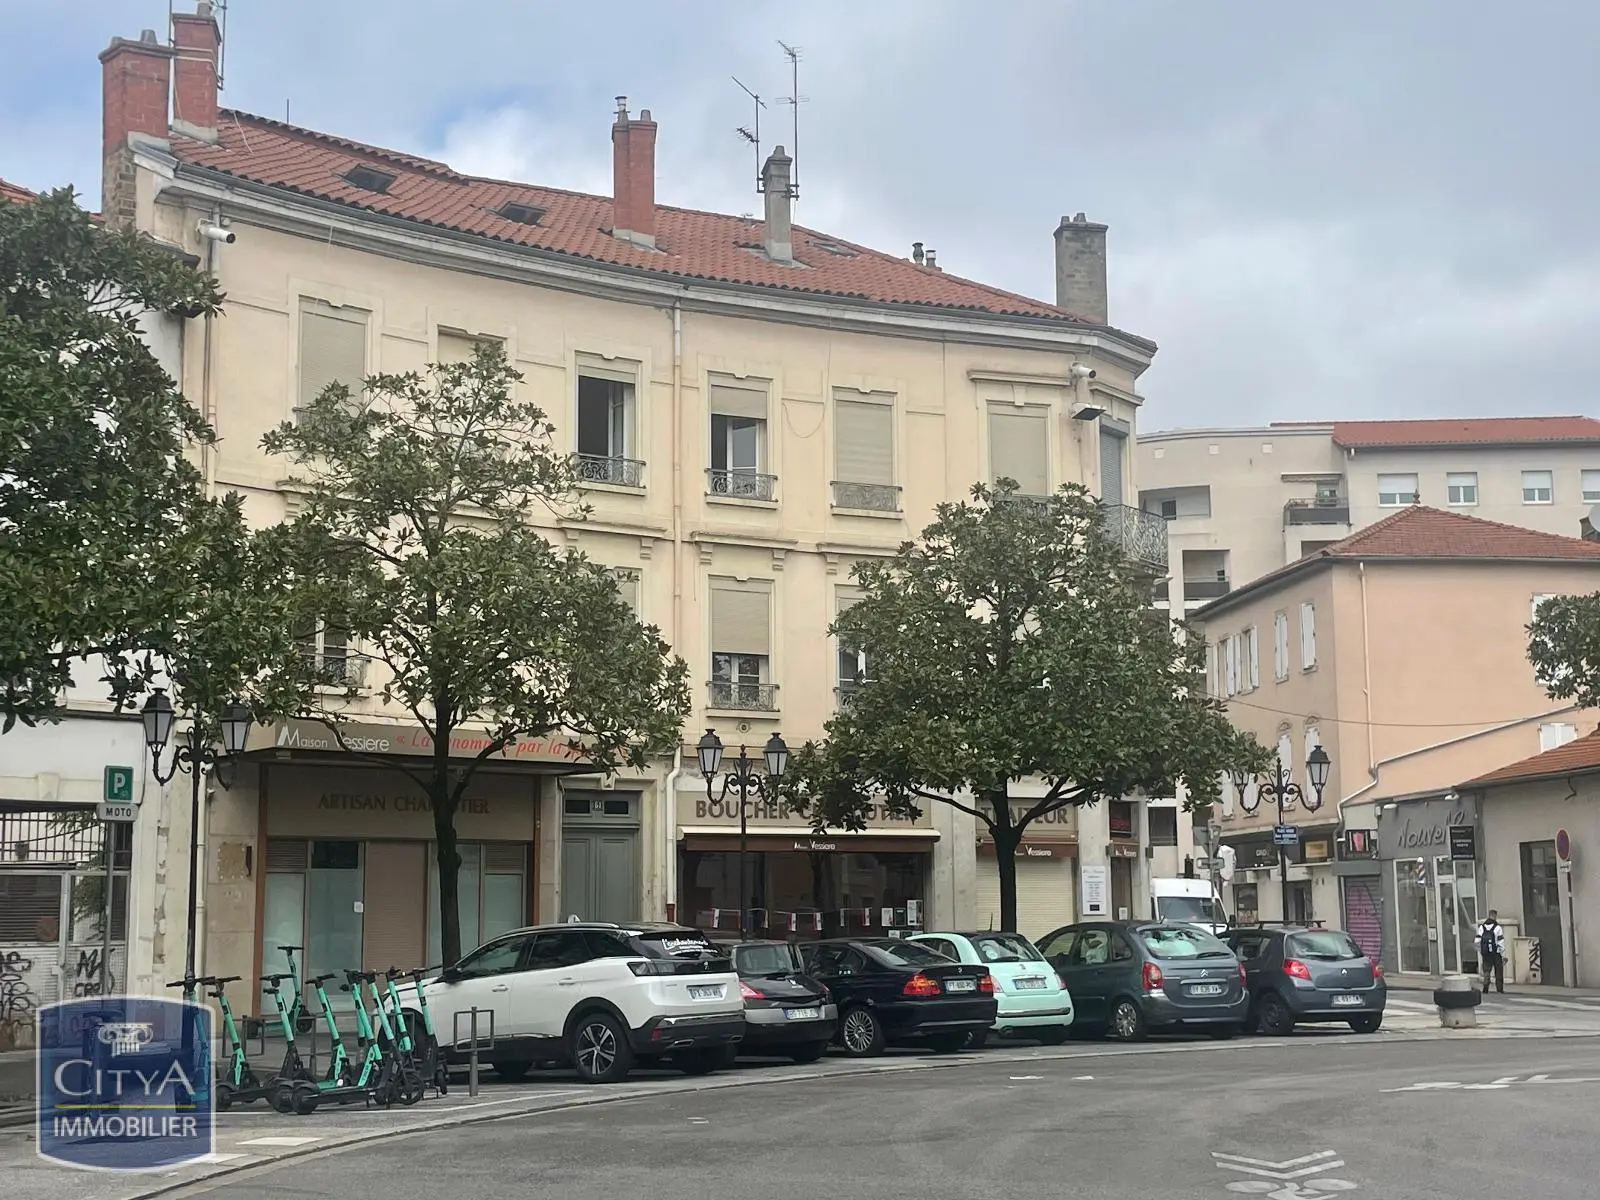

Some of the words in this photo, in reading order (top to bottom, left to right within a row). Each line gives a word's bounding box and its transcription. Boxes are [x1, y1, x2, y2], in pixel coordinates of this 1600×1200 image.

[277, 725, 328, 748] Maison
[113, 772, 126, 794] P
[105, 807, 132, 817] MOTO
[317, 793, 386, 811] ARTISAN
[695, 800, 790, 820] BOUCHER
